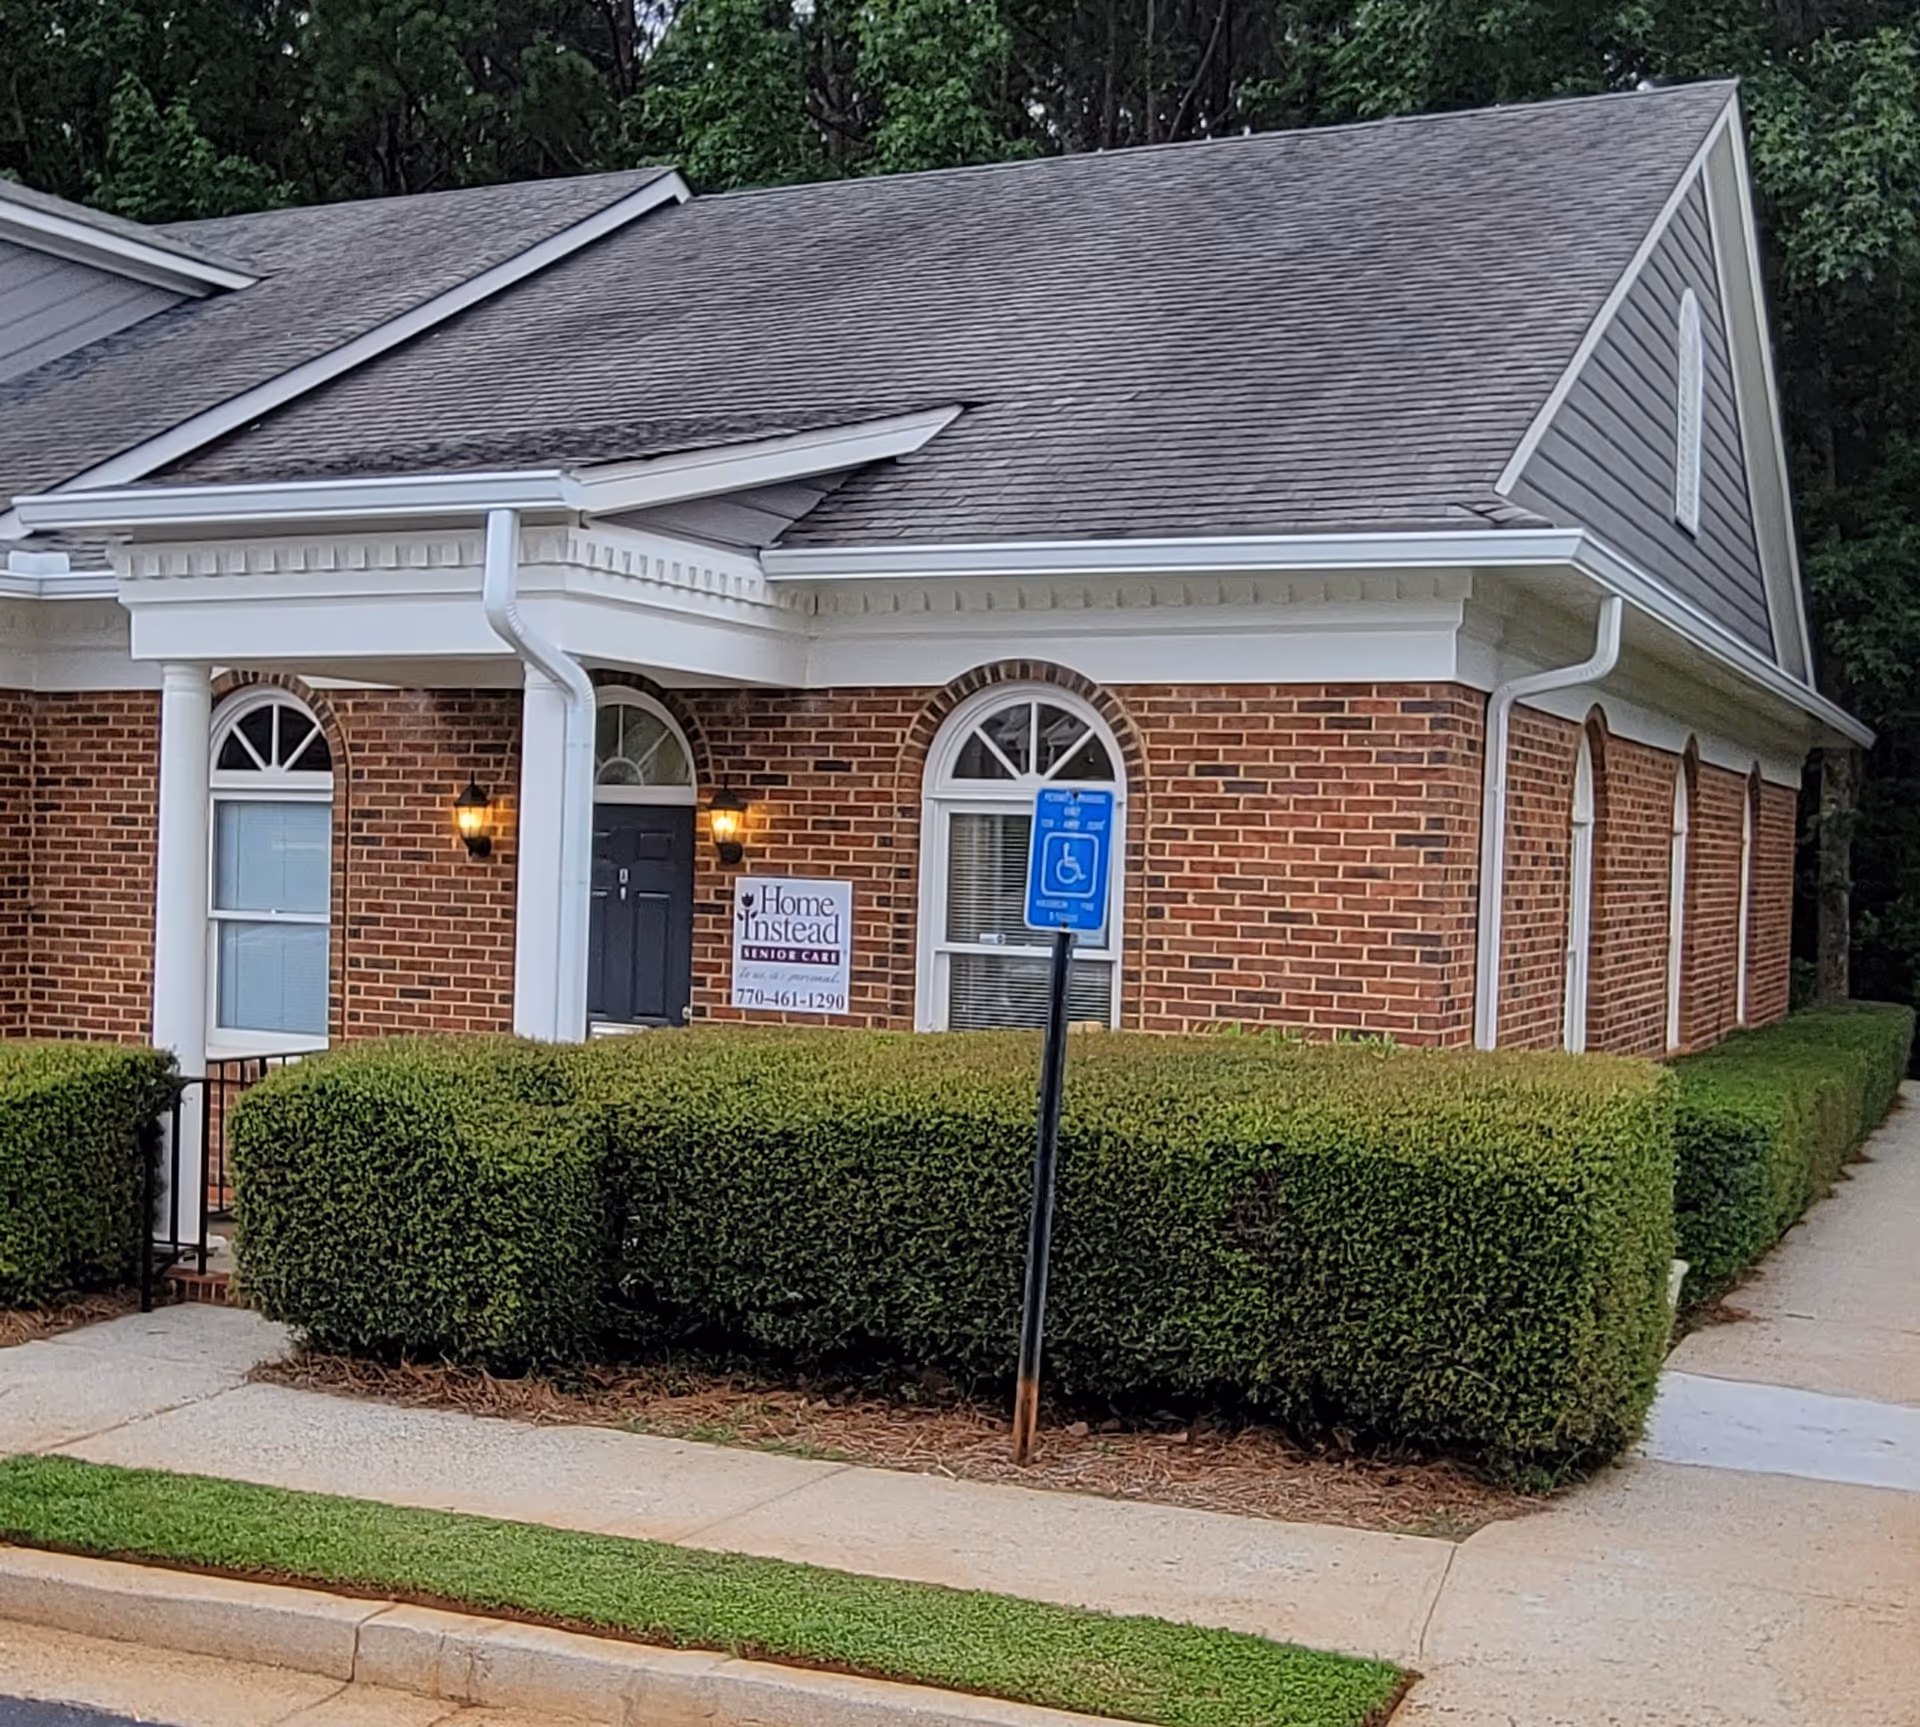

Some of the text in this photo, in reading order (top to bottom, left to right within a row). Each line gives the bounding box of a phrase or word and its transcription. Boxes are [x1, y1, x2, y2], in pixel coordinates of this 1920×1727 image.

[761, 885, 834, 917] Home
[742, 910, 840, 945] Instead
[744, 950, 838, 964] SENIOR CARE
[737, 988, 845, 1010] 770-461-1290
